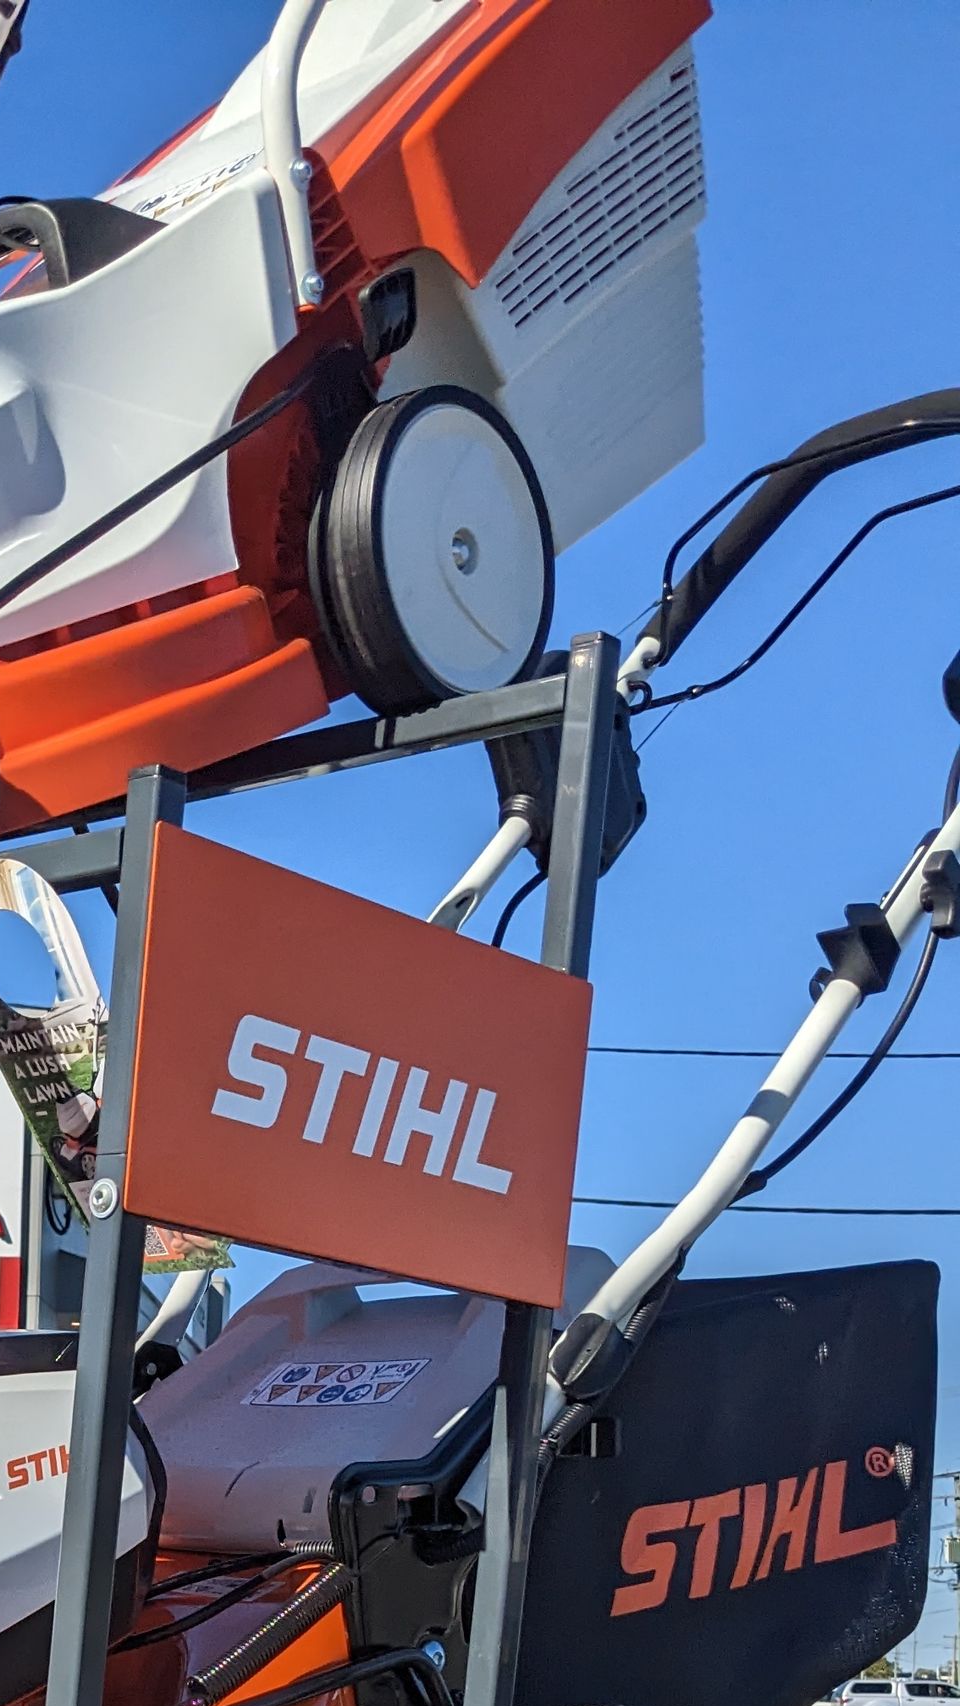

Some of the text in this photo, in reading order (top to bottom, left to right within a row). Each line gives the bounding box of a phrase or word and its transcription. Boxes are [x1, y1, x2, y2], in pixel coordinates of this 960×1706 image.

[0, 1022, 81, 1055] MAINTAIN
[14, 1053, 72, 1079] A LUSH
[24, 1081, 72, 1104] LAWN
[211, 1014, 513, 1195] STIHL
[7, 1445, 70, 1490] STI
[610, 1460, 897, 1617] STIHL
